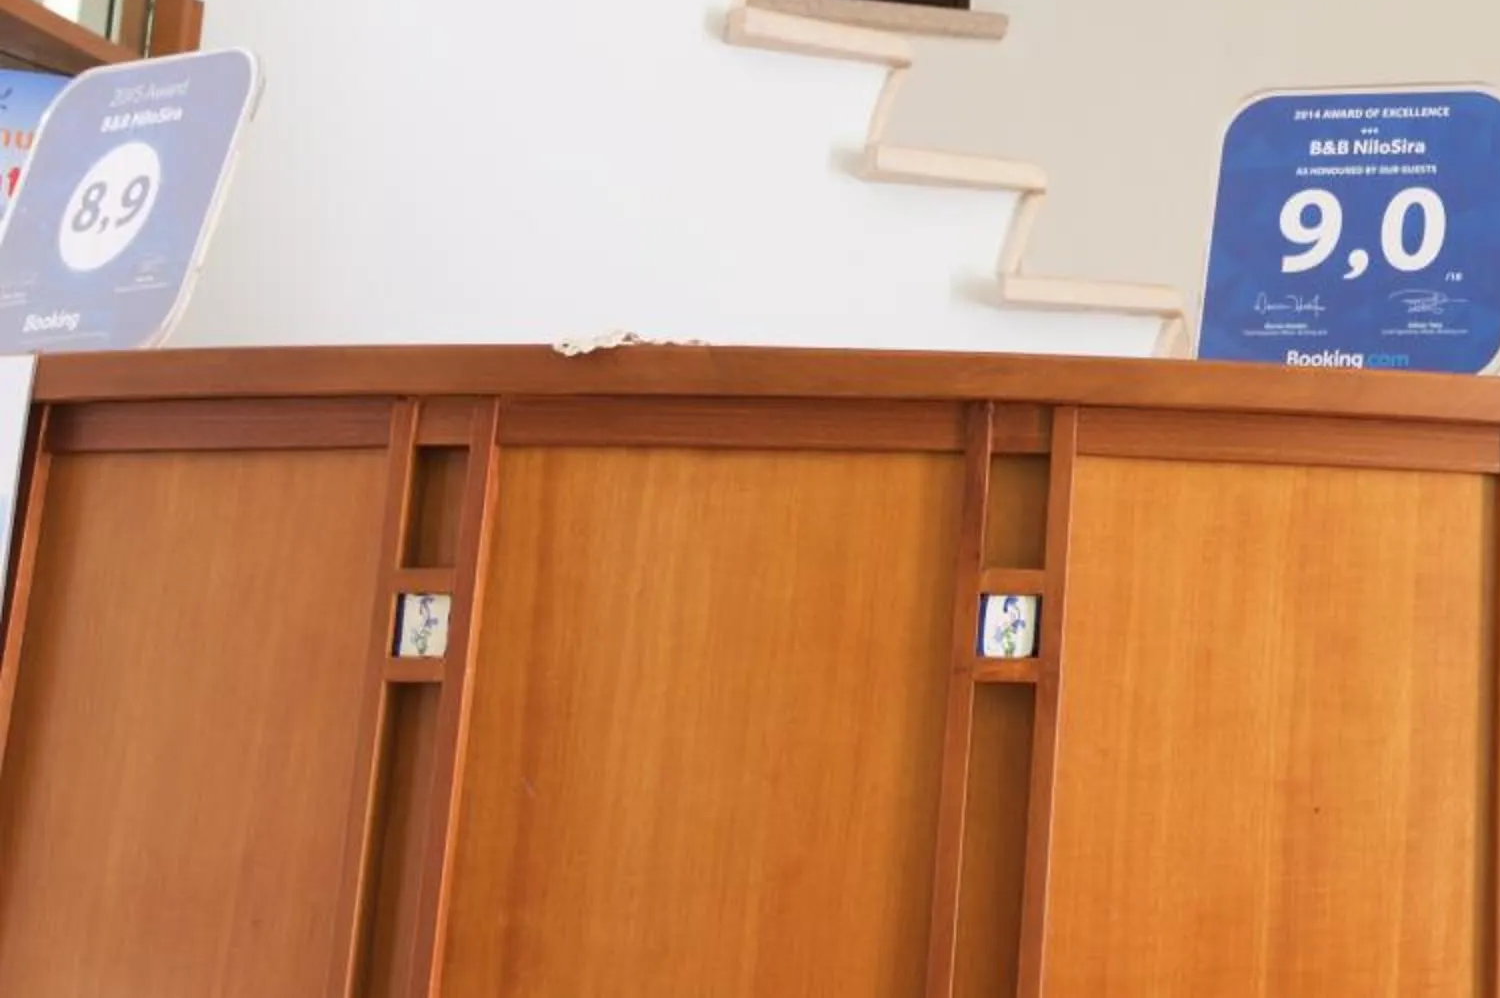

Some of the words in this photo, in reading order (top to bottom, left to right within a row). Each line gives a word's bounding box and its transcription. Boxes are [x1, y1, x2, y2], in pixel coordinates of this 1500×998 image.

[1294, 110, 1321, 120] 2014
[1322, 108, 1363, 119] AWARD
[1365, 108, 1379, 119] OF
[1382, 106, 1450, 118] EXCELLENCE
[1309, 139, 1349, 155] B&B
[1353, 137, 1426, 154] NiloSira
[70, 174, 151, 234] 8,9
[1279, 187, 1447, 280] 9,0
